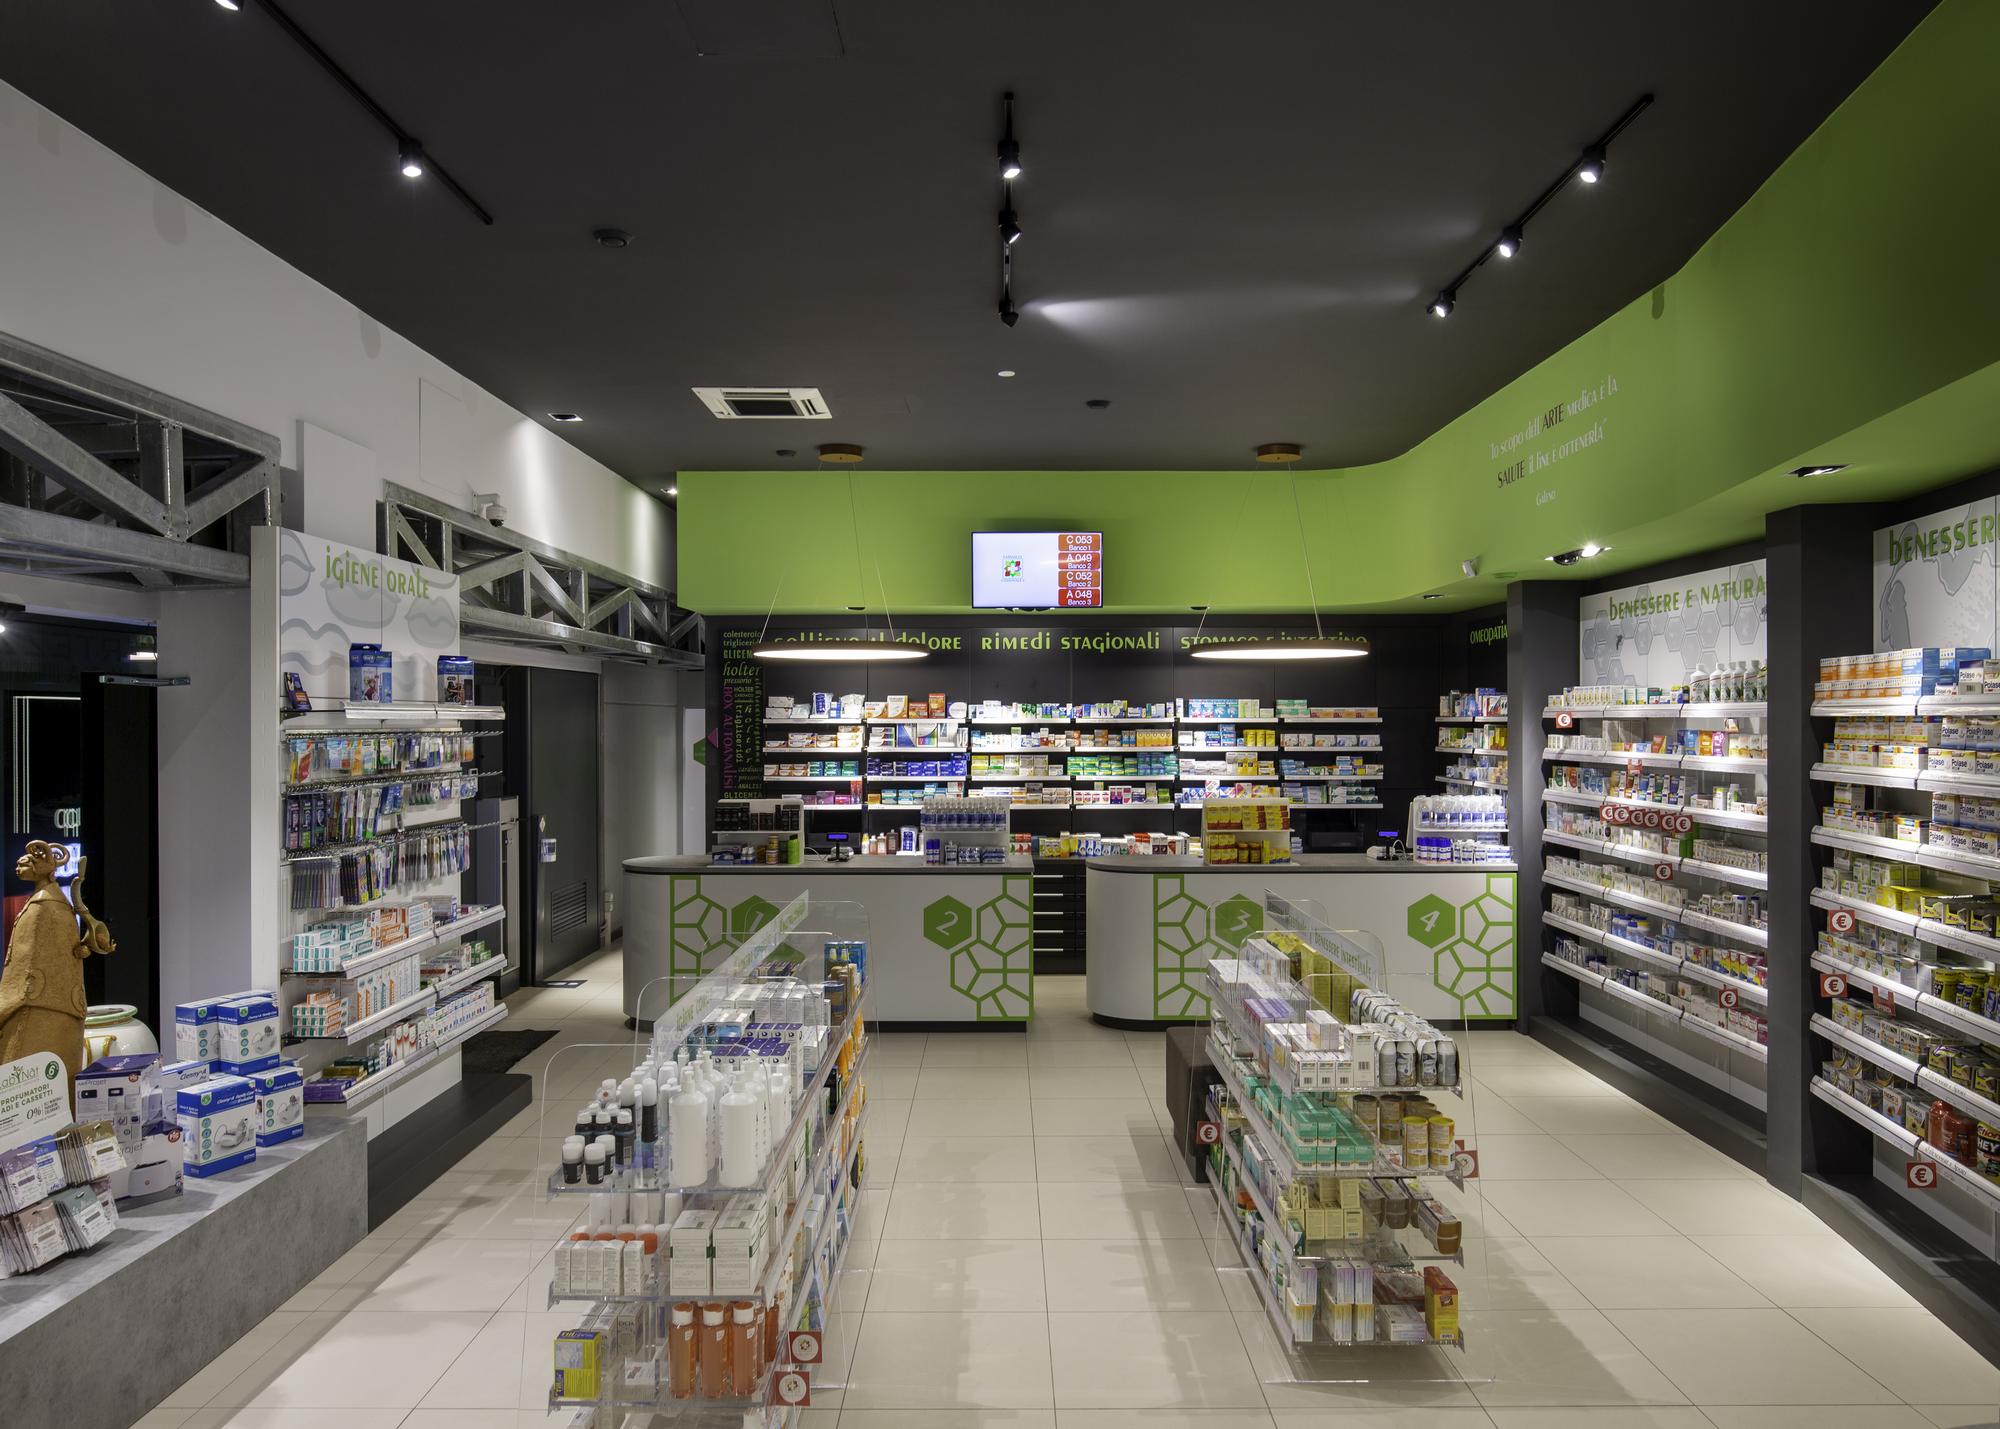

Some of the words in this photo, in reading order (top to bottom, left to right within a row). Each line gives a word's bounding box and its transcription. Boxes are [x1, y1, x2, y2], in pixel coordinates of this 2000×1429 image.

[1542, 403, 1564, 432] ARTE
[1066, 535, 1073, 544] C
[1075, 535, 1092, 544] 053
[1067, 553, 1074, 562] A
[1075, 553, 1092, 562] 049
[1066, 572, 1073, 580] C
[1075, 572, 1092, 580] 052
[1066, 590, 1074, 598] A
[1075, 590, 1092, 598] 048
[1686, 589, 1693, 608] E
[1701, 575, 1767, 605] NATURA
[723, 661, 760, 676] holter
[723, 687, 733, 709] BOX
[1929, 758, 1944, 766] Polase
[1952, 759, 1967, 767] Polase
[1976, 760, 1993, 769] Polase
[1960, 804, 1975, 813] Polase
[1952, 835, 1967, 845] Polase
[1972, 839, 1988, 849] Polase
[936, 911, 959, 936] 2
[1419, 910, 1440, 932] 4
[1836, 915, 1847, 928] €
[1828, 979, 1839, 992] €
[48, 1065, 56, 1076] 6
[1, 1083, 49, 1106] PROFUMATORI
[15, 1101, 20, 1109] E
[21, 1089, 53, 1106] CASSETTI
[26, 1106, 41, 1120] 0%
[1204, 1127, 1213, 1139] €
[1915, 1168, 1927, 1183] €
